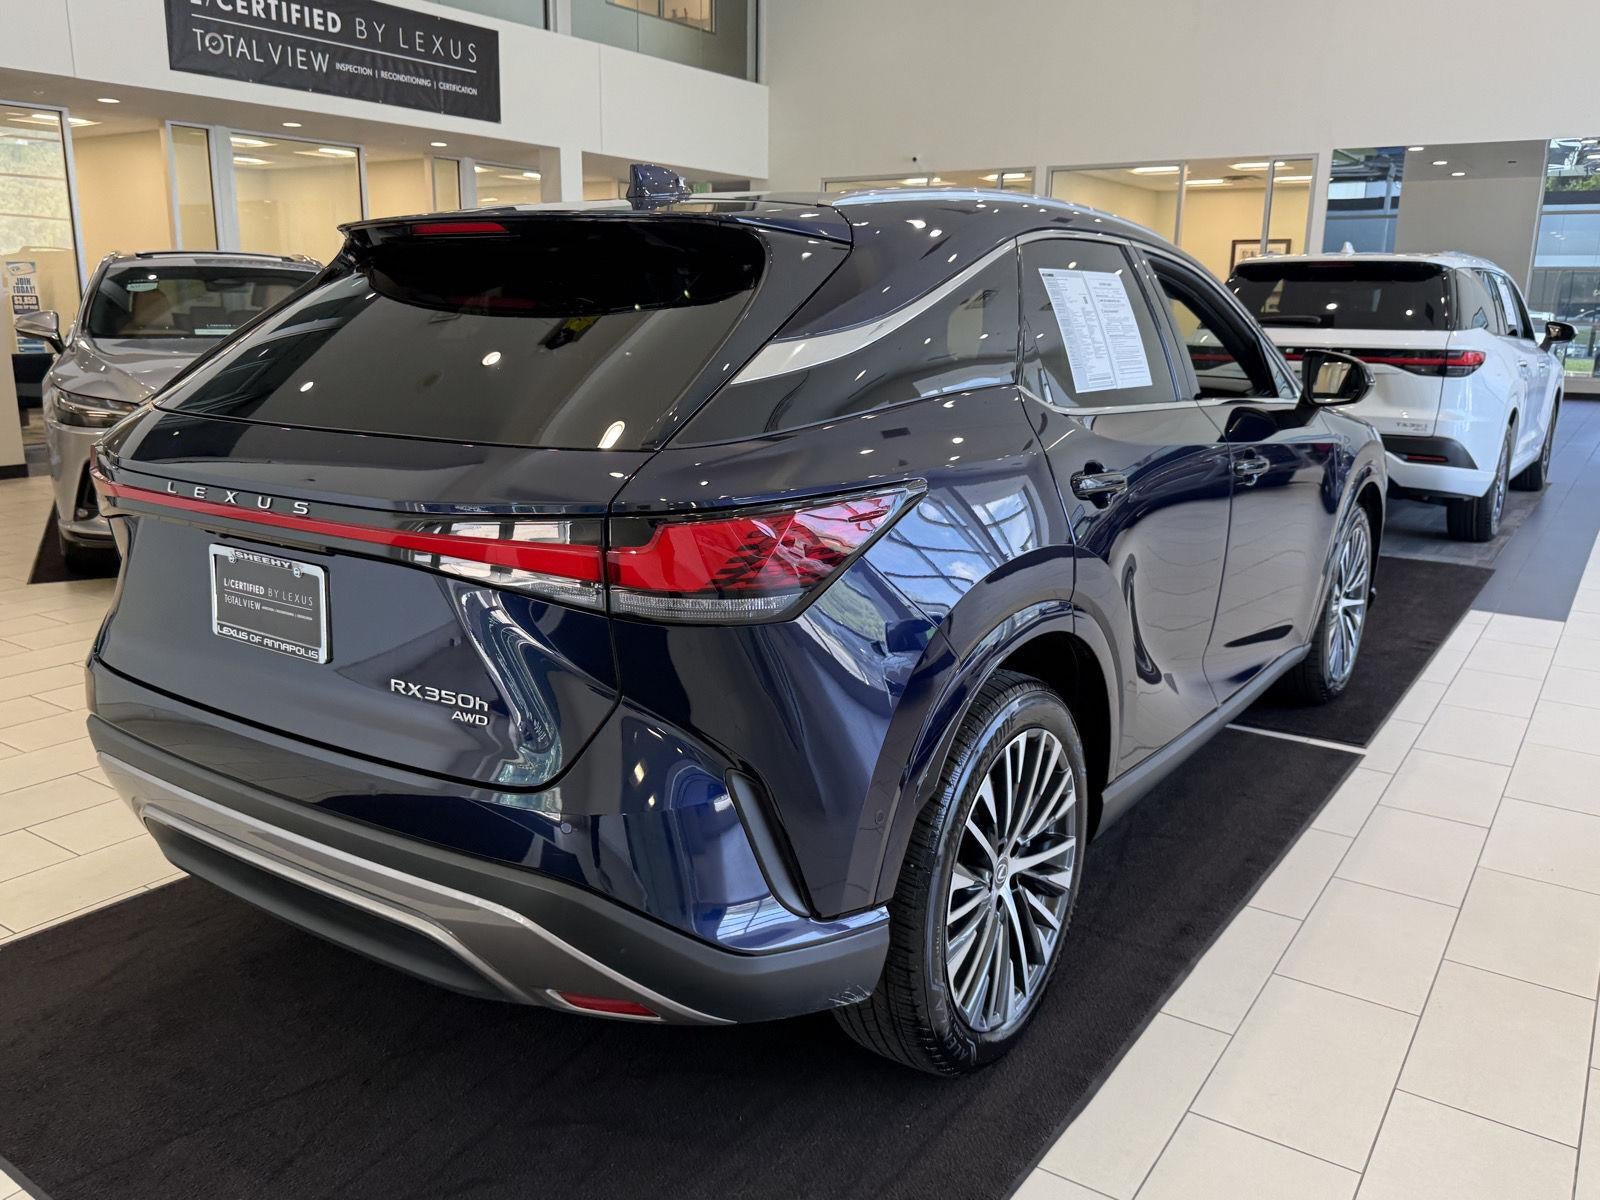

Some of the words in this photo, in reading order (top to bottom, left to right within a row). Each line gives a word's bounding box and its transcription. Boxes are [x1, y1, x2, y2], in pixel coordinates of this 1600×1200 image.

[190, 0, 342, 34] CERTIFIED
[355, 17, 386, 43] BY
[399, 27, 477, 64] LEXUS
[335, 62, 373, 77] INSPECTION
[380, 70, 432, 88] RECONDITIONING
[438, 81, 478, 96] CERTIFICATION
[167, 481, 309, 515] LEXUS
[234, 551, 291, 569] SHEEHY
[223, 577, 265, 595] L/CERTIFIED
[267, 587, 279, 599] BY
[282, 591, 313, 607] LEXUS
[217, 624, 249, 640] LEXUS
[249, 633, 263, 644] OF
[263, 637, 319, 659] ANNAPOLIS
[451, 710, 488, 726] AWD
